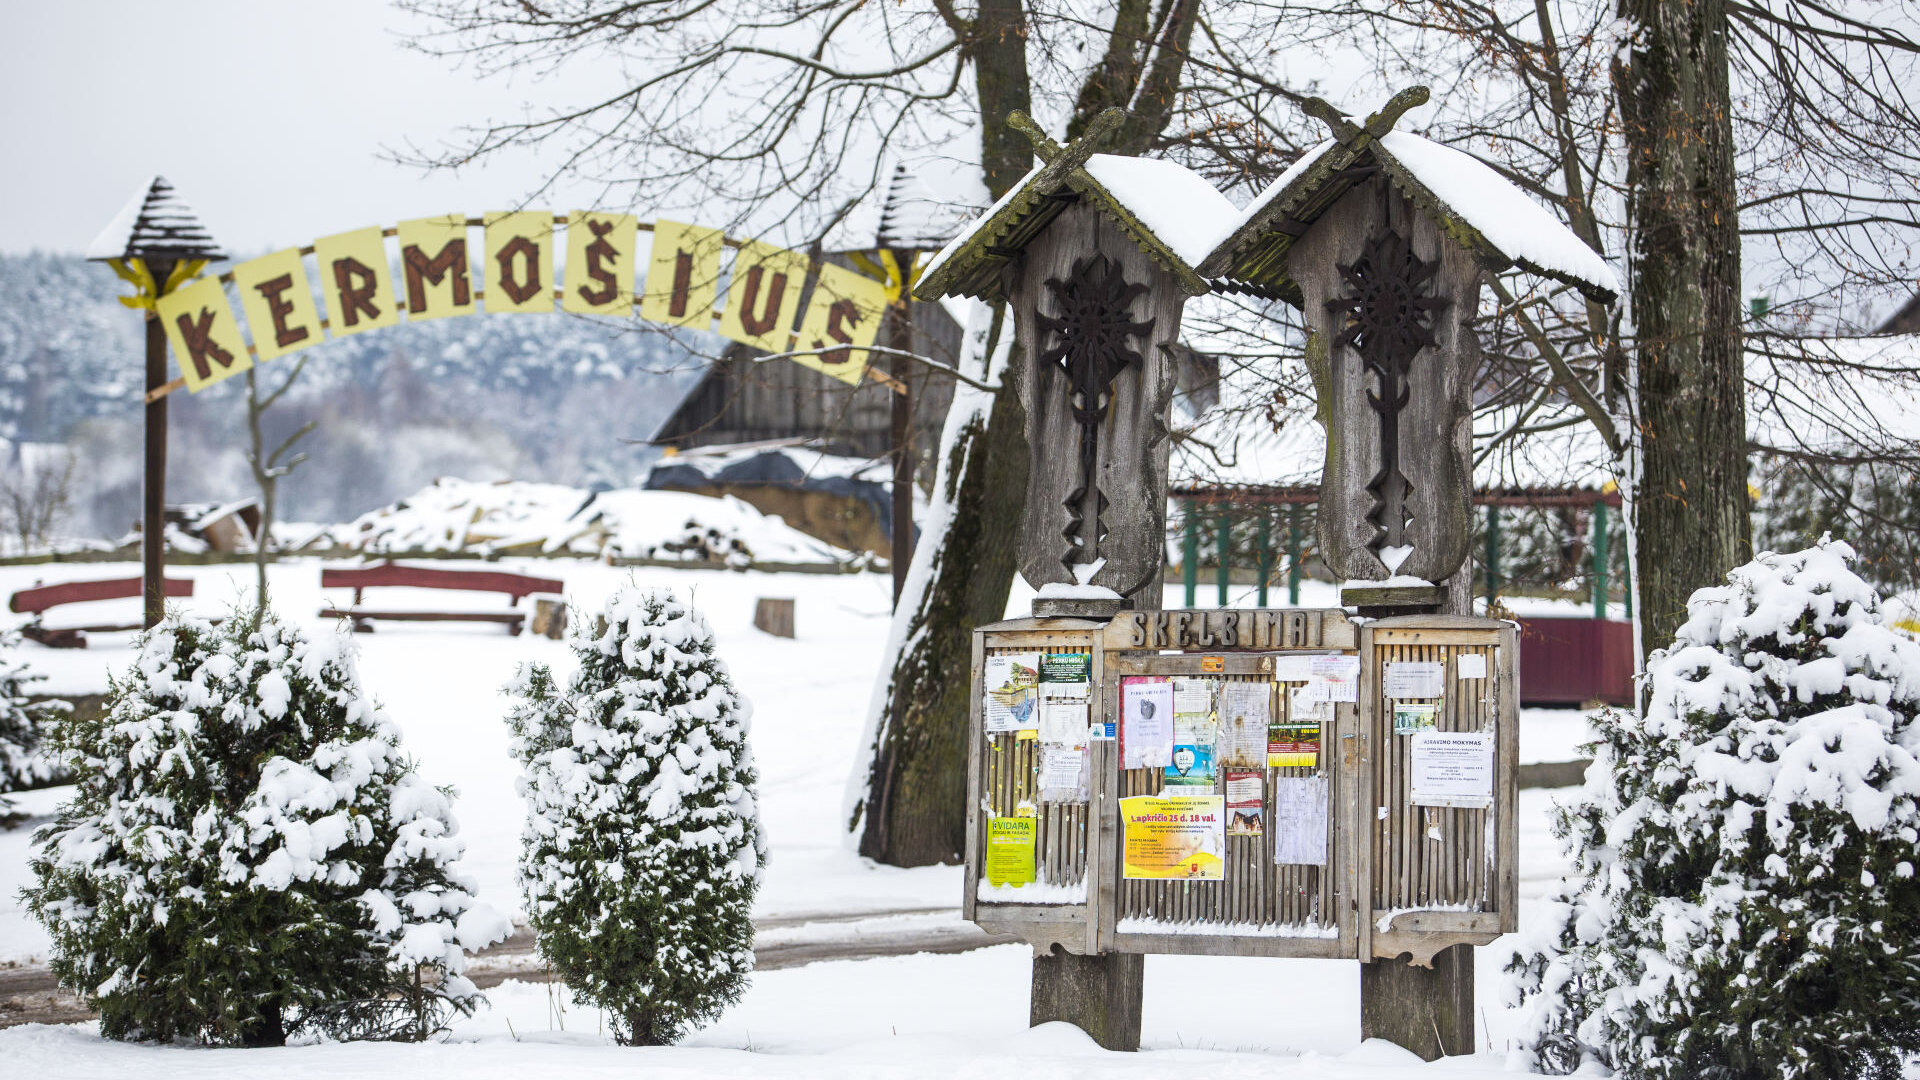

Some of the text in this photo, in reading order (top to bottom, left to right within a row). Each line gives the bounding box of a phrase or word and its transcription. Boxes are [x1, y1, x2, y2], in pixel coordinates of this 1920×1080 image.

[176, 219, 863, 380] KERMOŠIUS
[1130, 611, 1322, 646] SKELBIMAI
[1131, 813, 1168, 823] Lapkričio
[1169, 814, 1178, 822] 25
[1180, 814, 1188, 822] d.
[1201, 814, 1216, 822] val.
